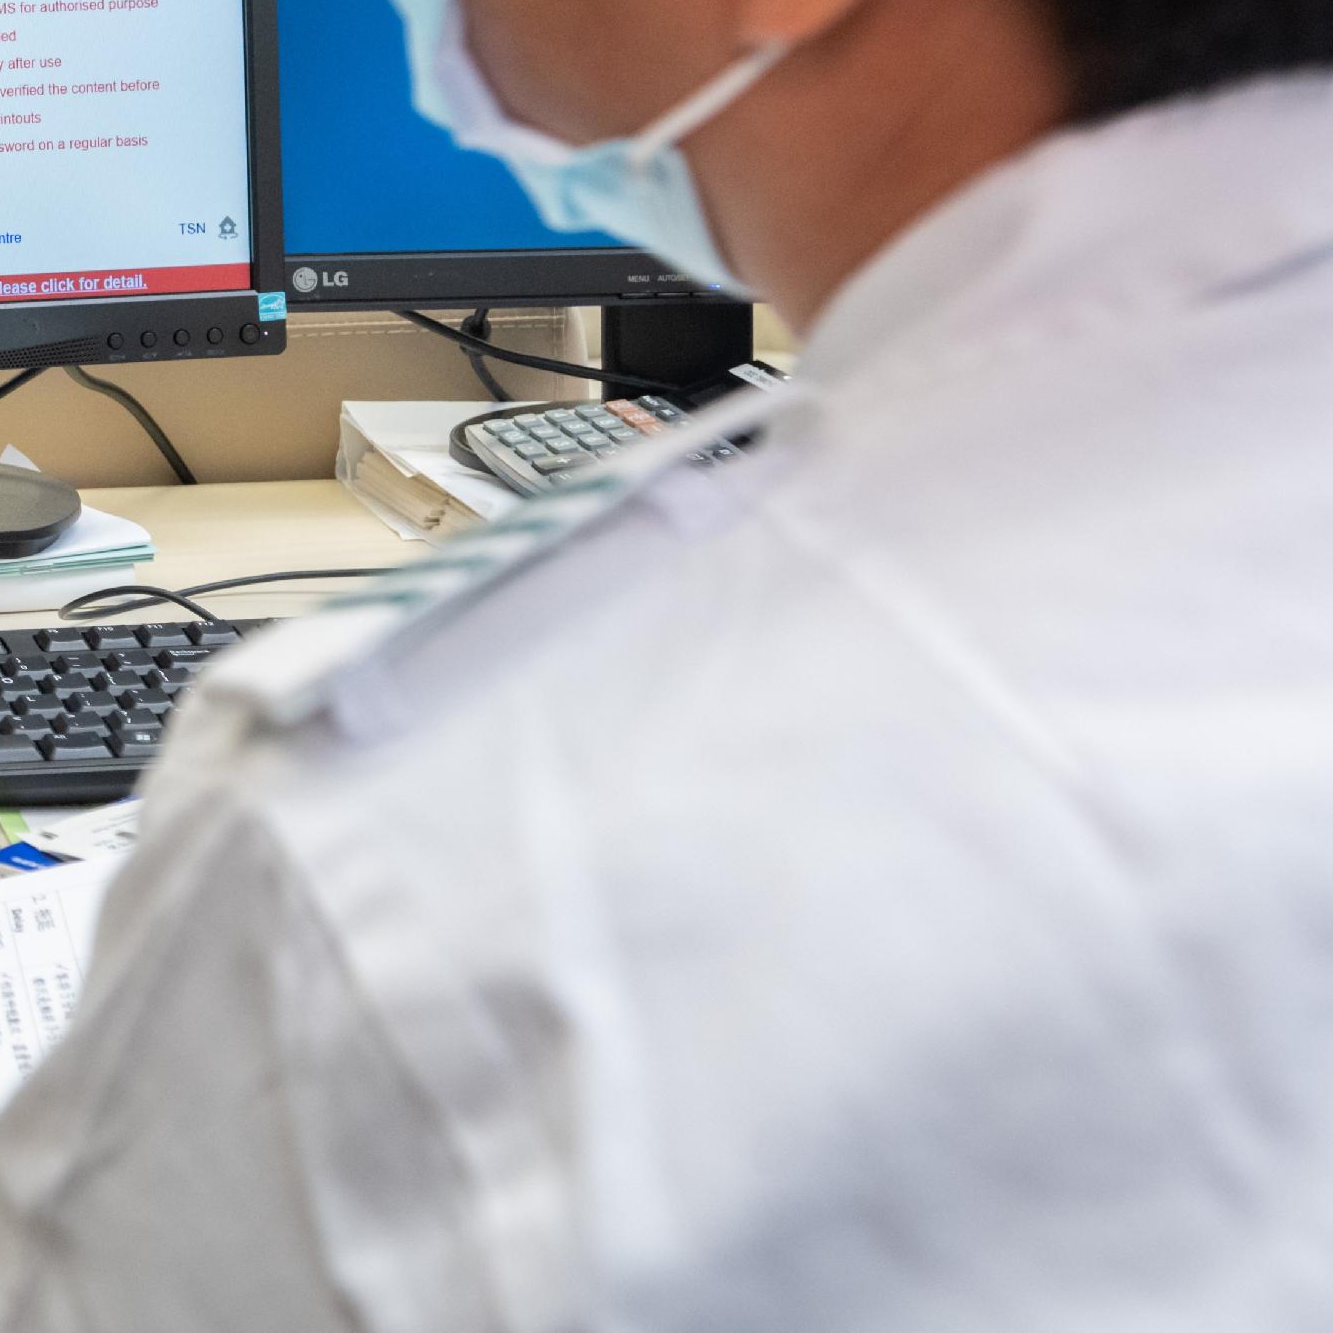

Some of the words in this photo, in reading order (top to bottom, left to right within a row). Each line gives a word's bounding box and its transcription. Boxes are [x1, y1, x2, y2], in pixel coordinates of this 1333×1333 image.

[8, 57, 35, 69] after
[40, 57, 62, 68] use
[179, 223, 206, 235] TSN
[41, 277, 74, 294] click
[79, 275, 99, 291] for
[104, 273, 147, 290] detail.
[322, 271, 348, 288] LG
[627, 274, 650, 283] MENU
